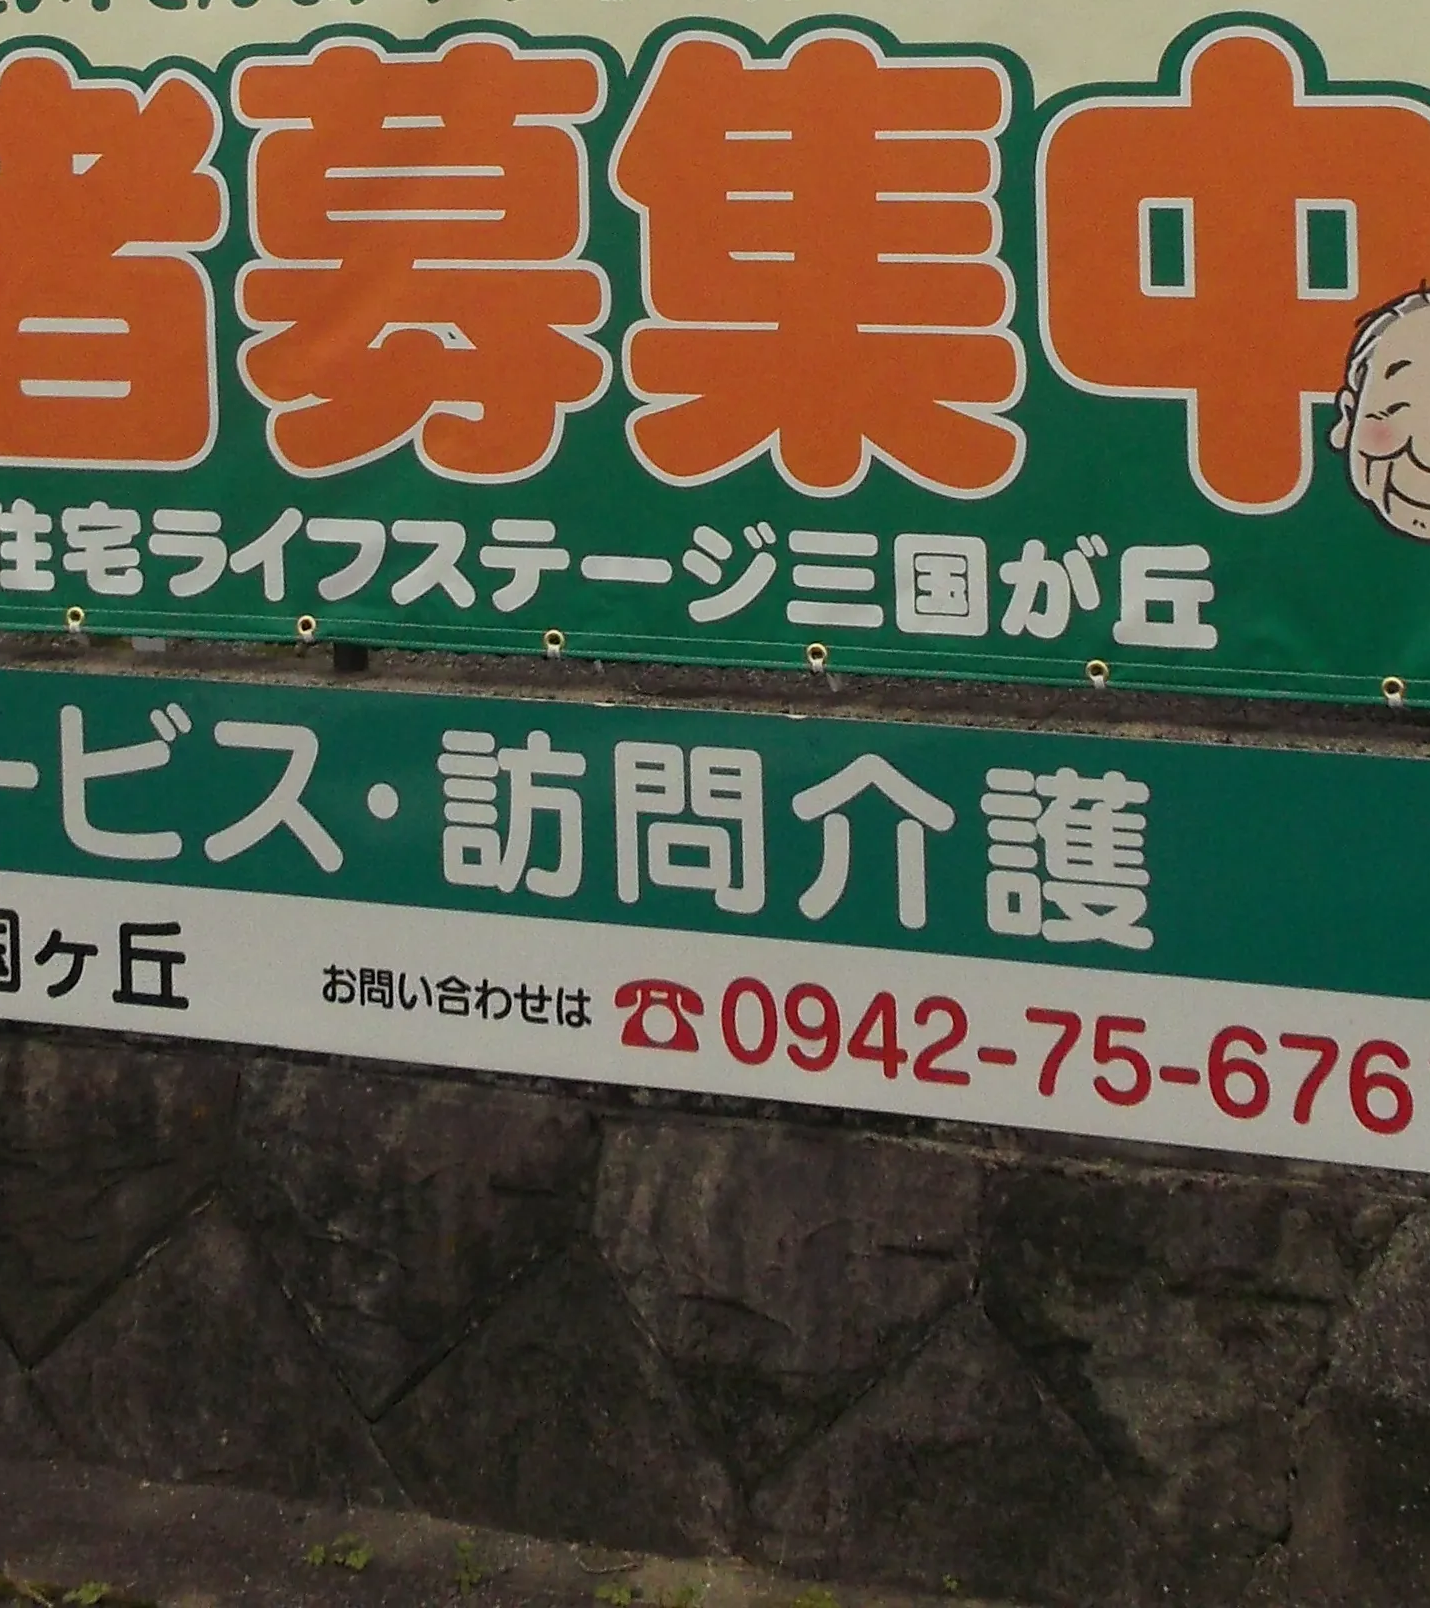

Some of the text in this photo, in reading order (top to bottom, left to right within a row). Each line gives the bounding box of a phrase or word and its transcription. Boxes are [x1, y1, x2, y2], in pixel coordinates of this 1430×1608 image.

[320, 964, 592, 1030] お問い合わせは
